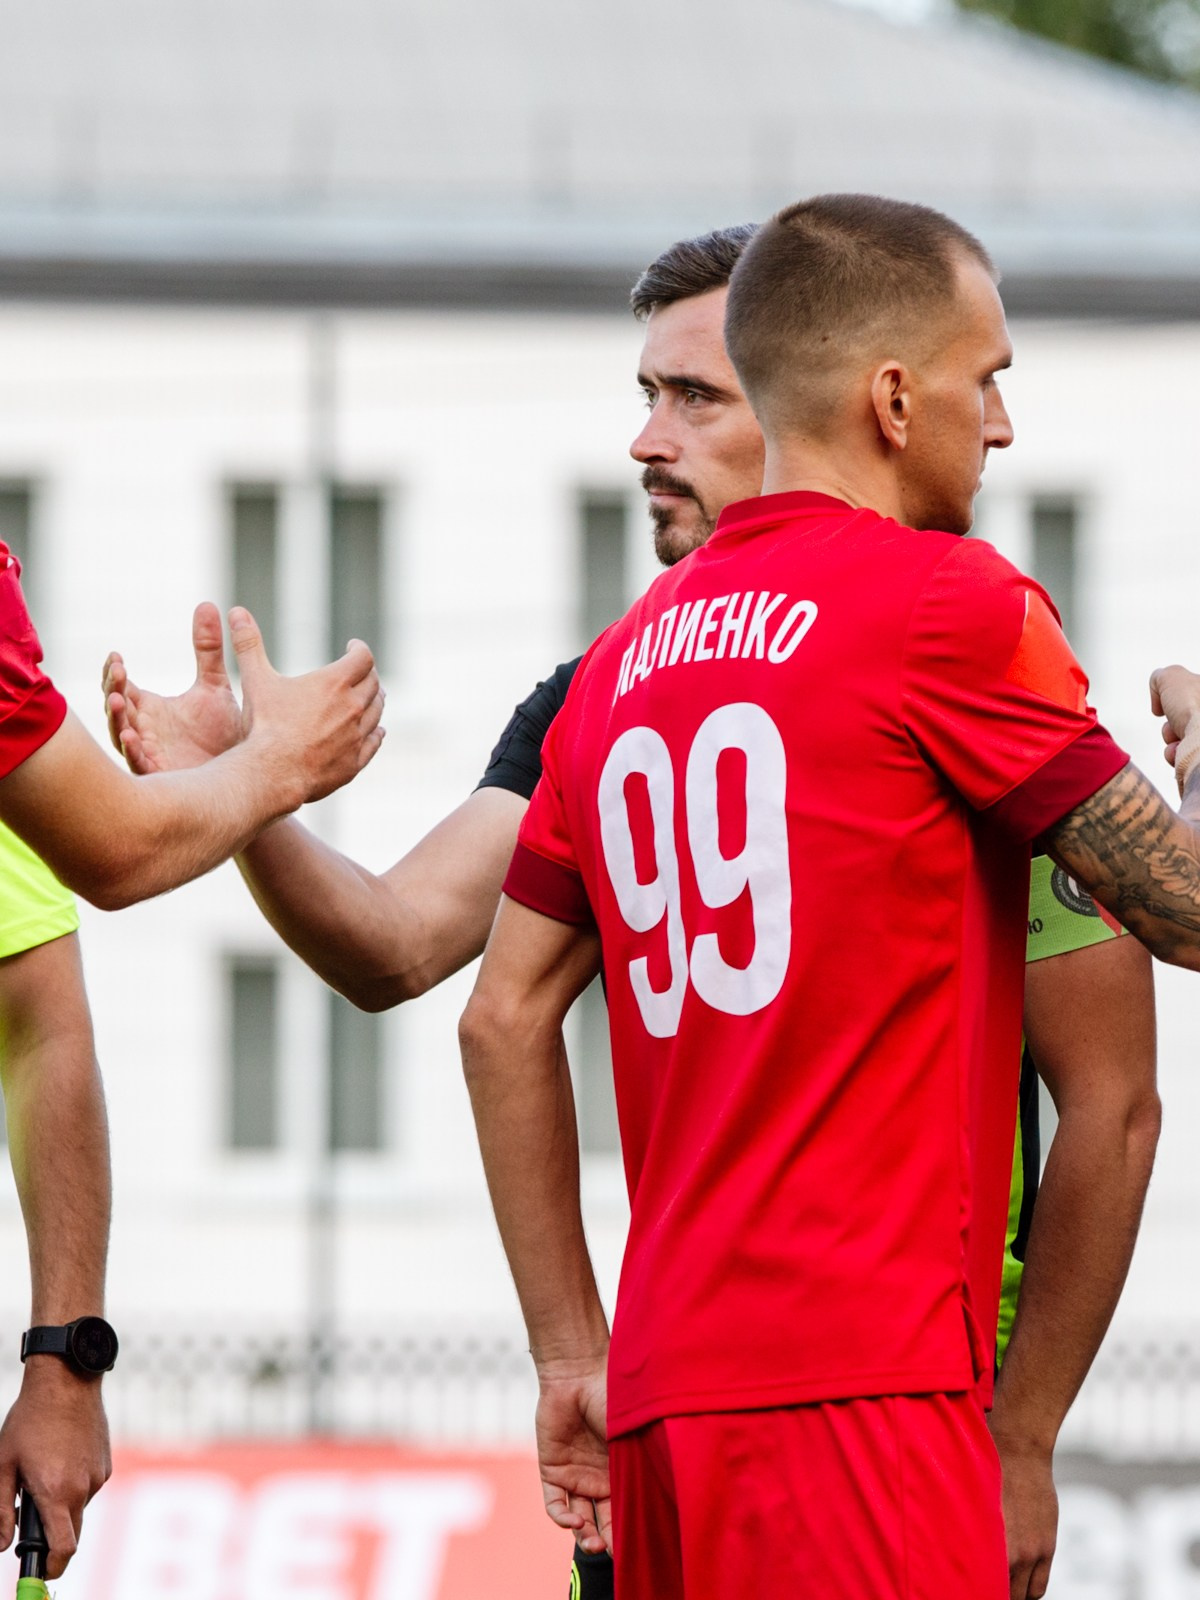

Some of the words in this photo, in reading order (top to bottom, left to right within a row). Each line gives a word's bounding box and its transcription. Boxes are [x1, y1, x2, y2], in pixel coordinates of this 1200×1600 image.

[610, 590, 819, 711] ПАЛИЕНКО
[597, 702, 792, 1038] 99
[74, 1474, 487, 1600] BET
